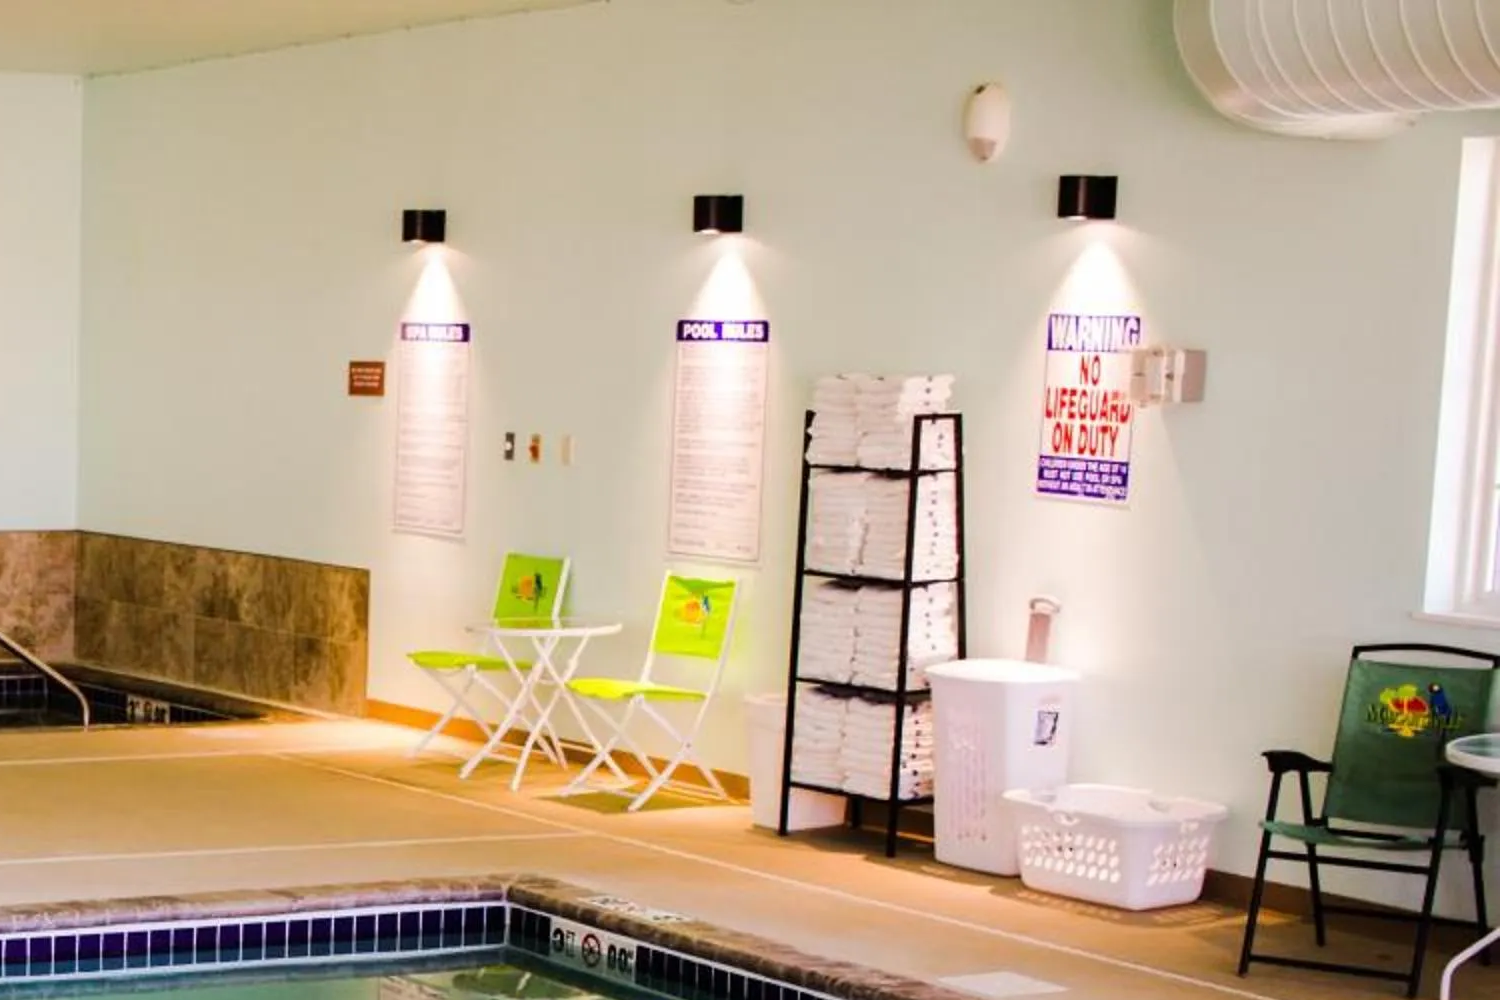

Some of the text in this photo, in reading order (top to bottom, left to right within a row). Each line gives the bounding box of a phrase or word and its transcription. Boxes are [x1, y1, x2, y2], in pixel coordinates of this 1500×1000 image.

[683, 323, 717, 339] POOL
[1051, 317, 1138, 351] WARNING
[1079, 354, 1101, 386] NO
[1044, 387, 1131, 424] LIFEGUARD
[1052, 421, 1120, 457] ON DUTY
